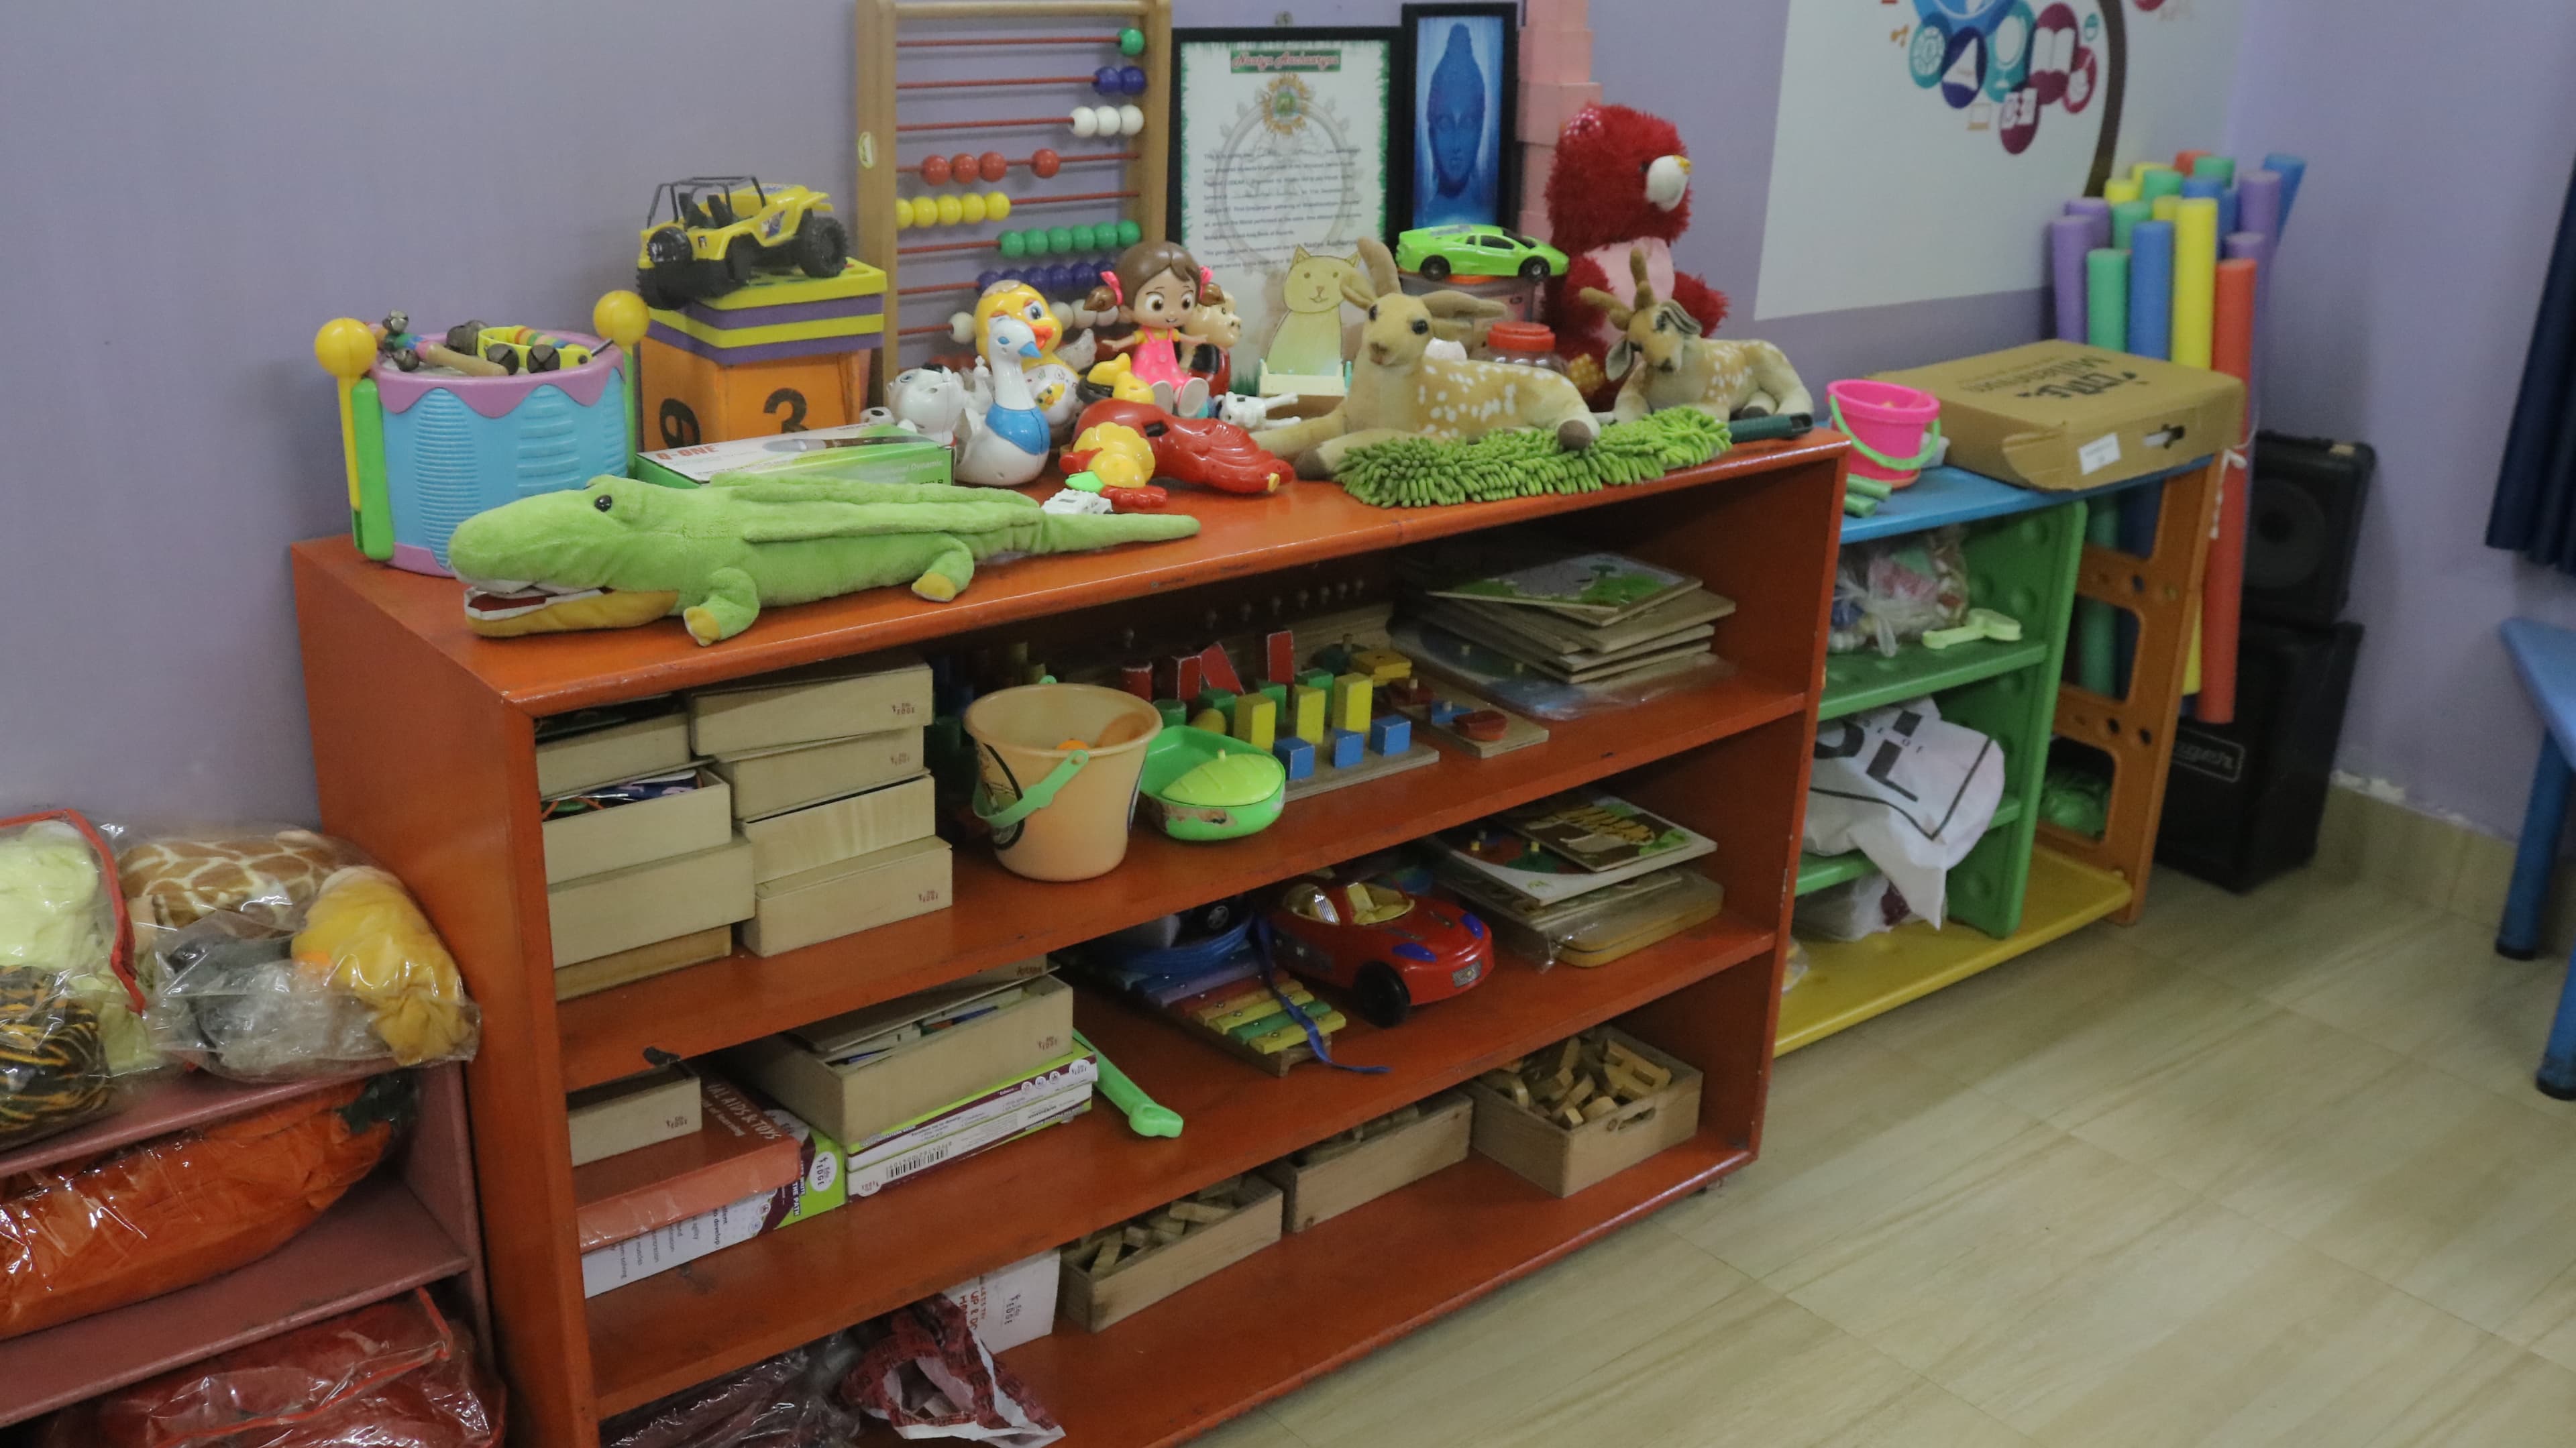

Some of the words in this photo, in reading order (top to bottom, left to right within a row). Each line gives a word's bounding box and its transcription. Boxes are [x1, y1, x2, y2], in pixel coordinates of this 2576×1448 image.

[722, 1097, 750, 1117] AIDS
[741, 1112, 758, 1123] &
[751, 1119, 783, 1140] TOYS
[816, 1164, 825, 1186] EDGE
